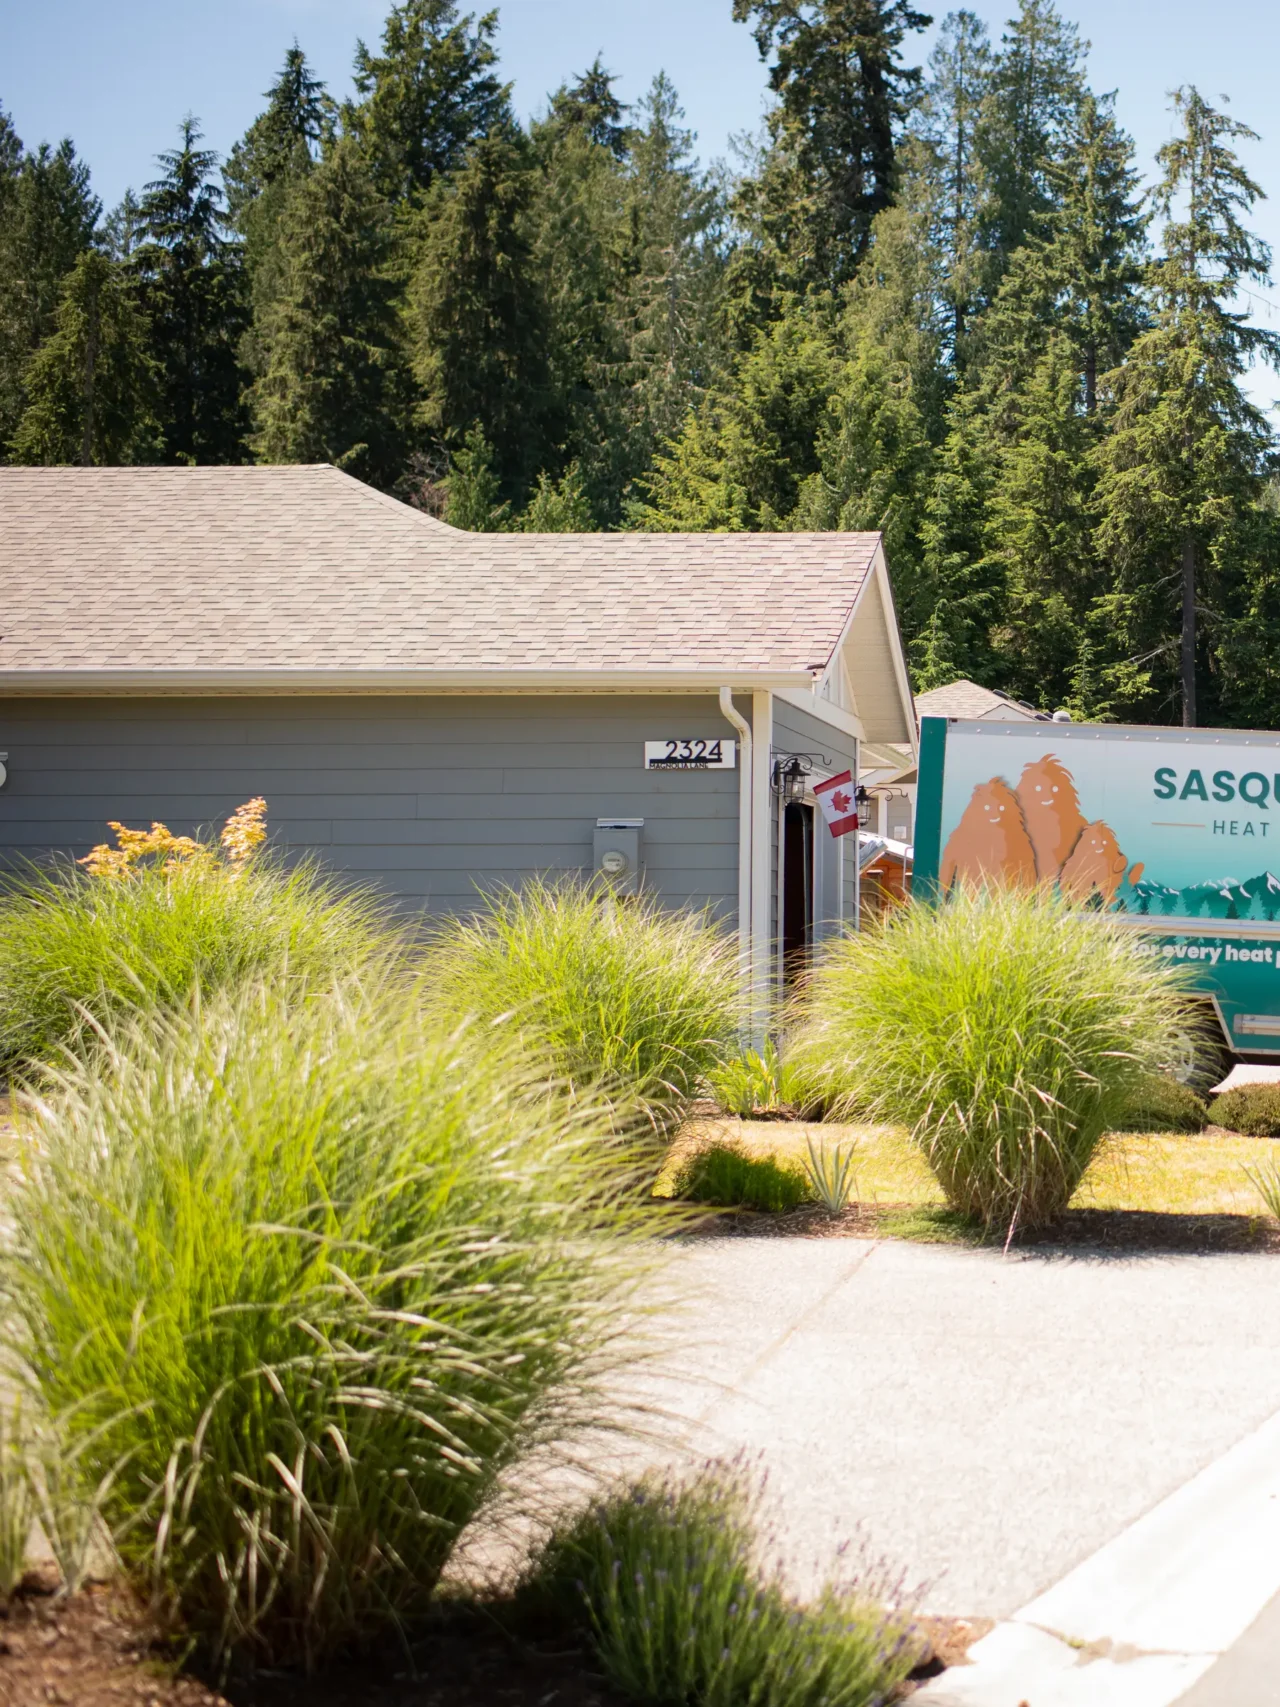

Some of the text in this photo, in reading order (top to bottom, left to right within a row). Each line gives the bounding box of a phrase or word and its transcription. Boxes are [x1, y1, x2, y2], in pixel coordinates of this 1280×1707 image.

[665, 740, 722, 760] 2324
[1213, 820, 1270, 837] HEAT
[1163, 944, 1222, 965] every
[1225, 945, 1273, 963] heat
